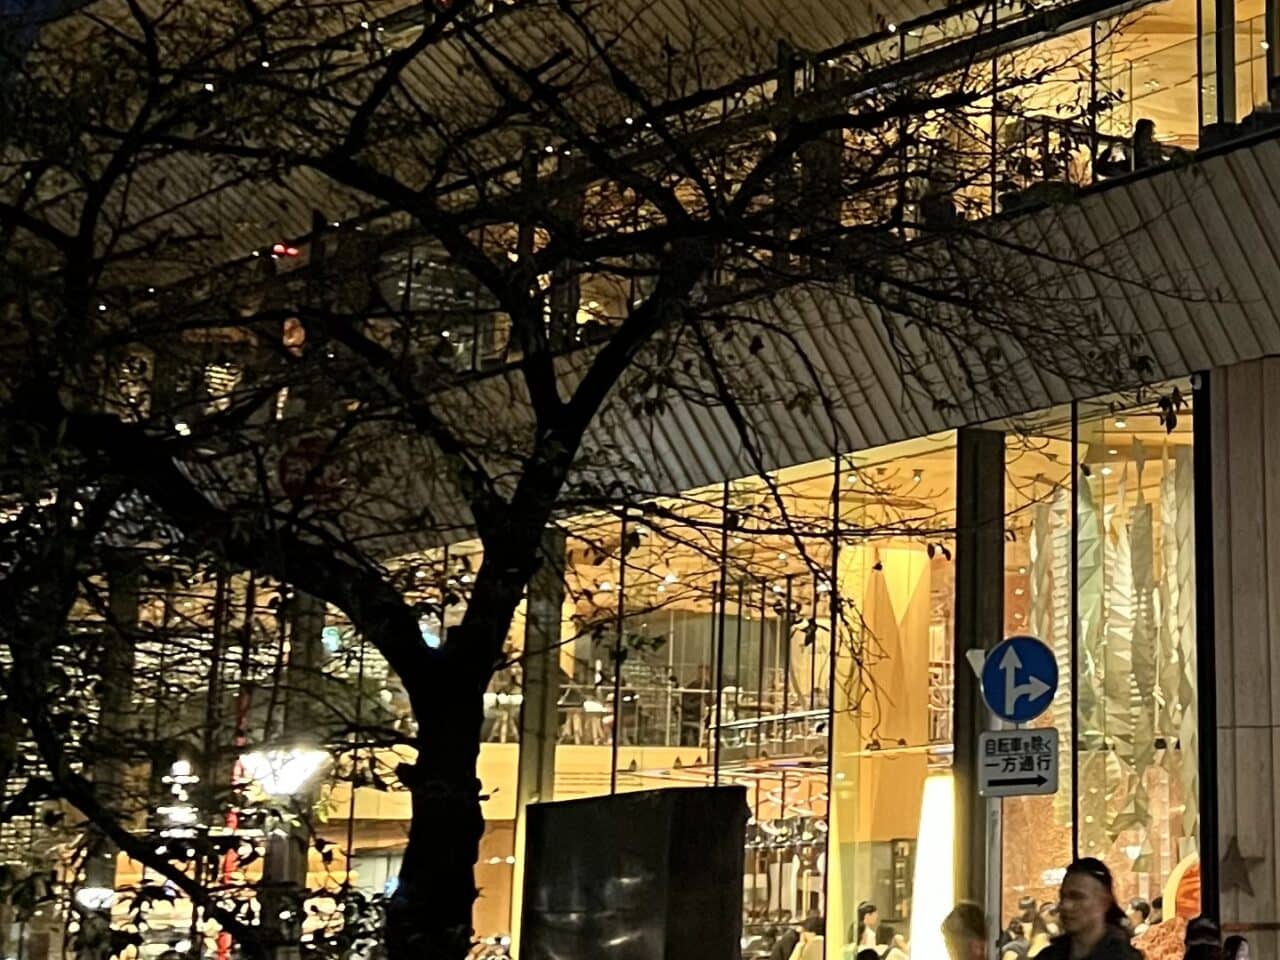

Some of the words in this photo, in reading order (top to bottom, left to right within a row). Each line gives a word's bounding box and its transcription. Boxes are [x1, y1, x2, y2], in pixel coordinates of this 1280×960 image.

[985, 735, 1052, 755] 自転車を除く
[984, 754, 1052, 773] 一方通行
